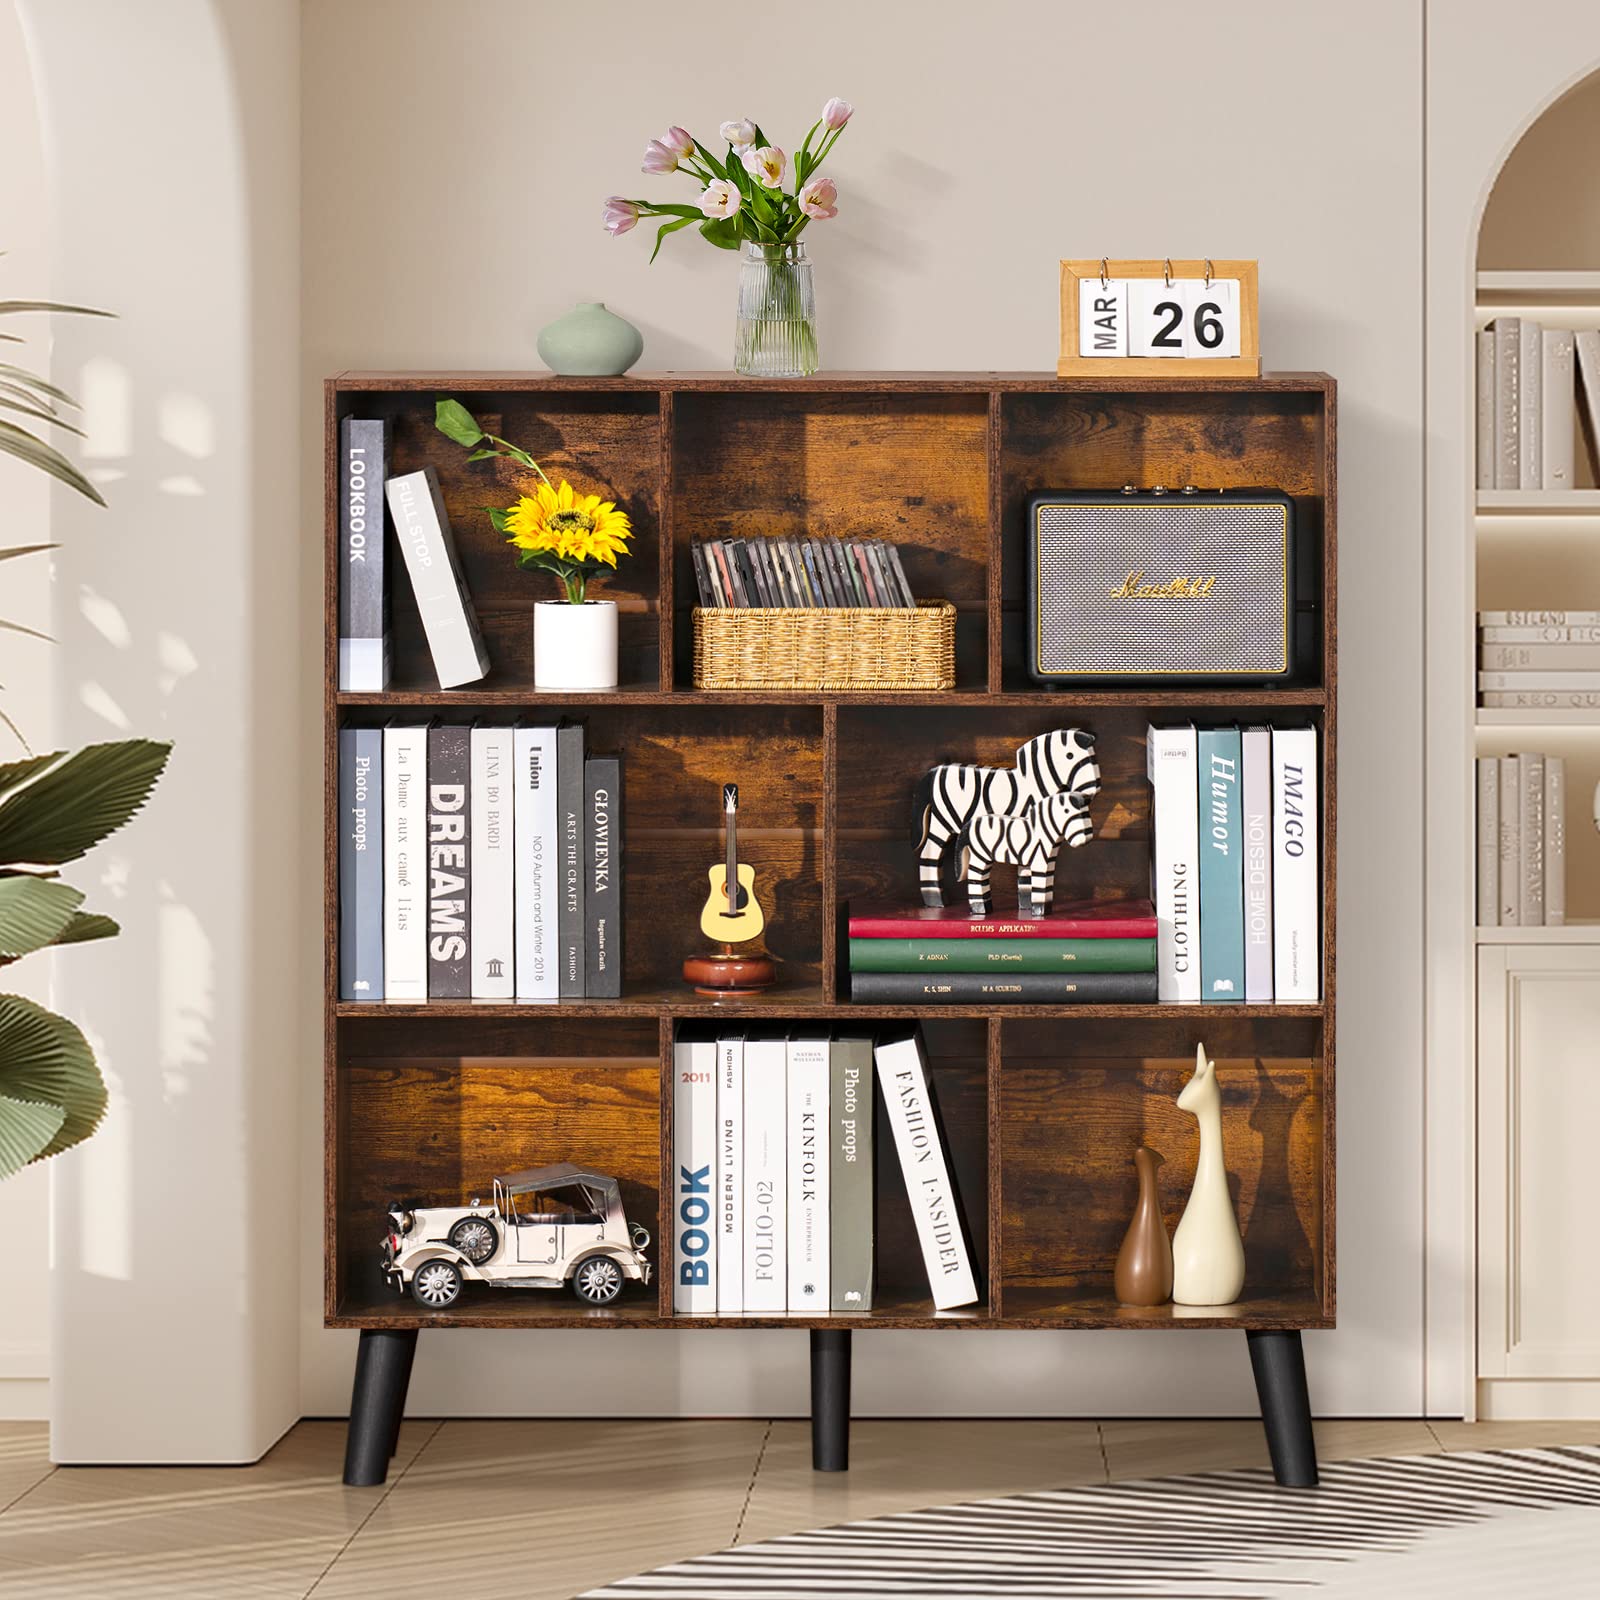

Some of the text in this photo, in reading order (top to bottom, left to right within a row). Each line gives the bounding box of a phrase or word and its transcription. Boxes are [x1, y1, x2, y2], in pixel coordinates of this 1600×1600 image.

[1094, 297, 1117, 350] MAR
[1151, 302, 1224, 348] 26
[350, 448, 366, 563] LOOKBOOK
[396, 481, 416, 523] FULL
[352, 756, 370, 851] Photo props
[487, 746, 500, 850] LINA BO BARDI
[530, 746, 542, 790] Union
[1211, 754, 1235, 856] Humor
[1284, 763, 1304, 857] IMAGO
[398, 747, 411, 930] La Dame aux camé lias
[430, 784, 466, 961] DREAMS
[567, 812, 577, 912] ARTS THE CRAFTS
[594, 789, 609, 892] GŁOWIENKA
[532, 836, 544, 982] NO.9 Autumn and Winter 2018
[1172, 863, 1188, 973] CLOTHING
[1250, 890, 1267, 944] HOME
[682, 1072, 710, 1083] 2011
[842, 1068, 859, 1162] Photo props
[895, 1071, 933, 1164] FASHION
[725, 1119, 734, 1234] MODERN LIVING
[803, 1113, 815, 1202] KINFOLK
[680, 1165, 710, 1286] BOOK
[755, 1181, 774, 1281] FOLIO-02
